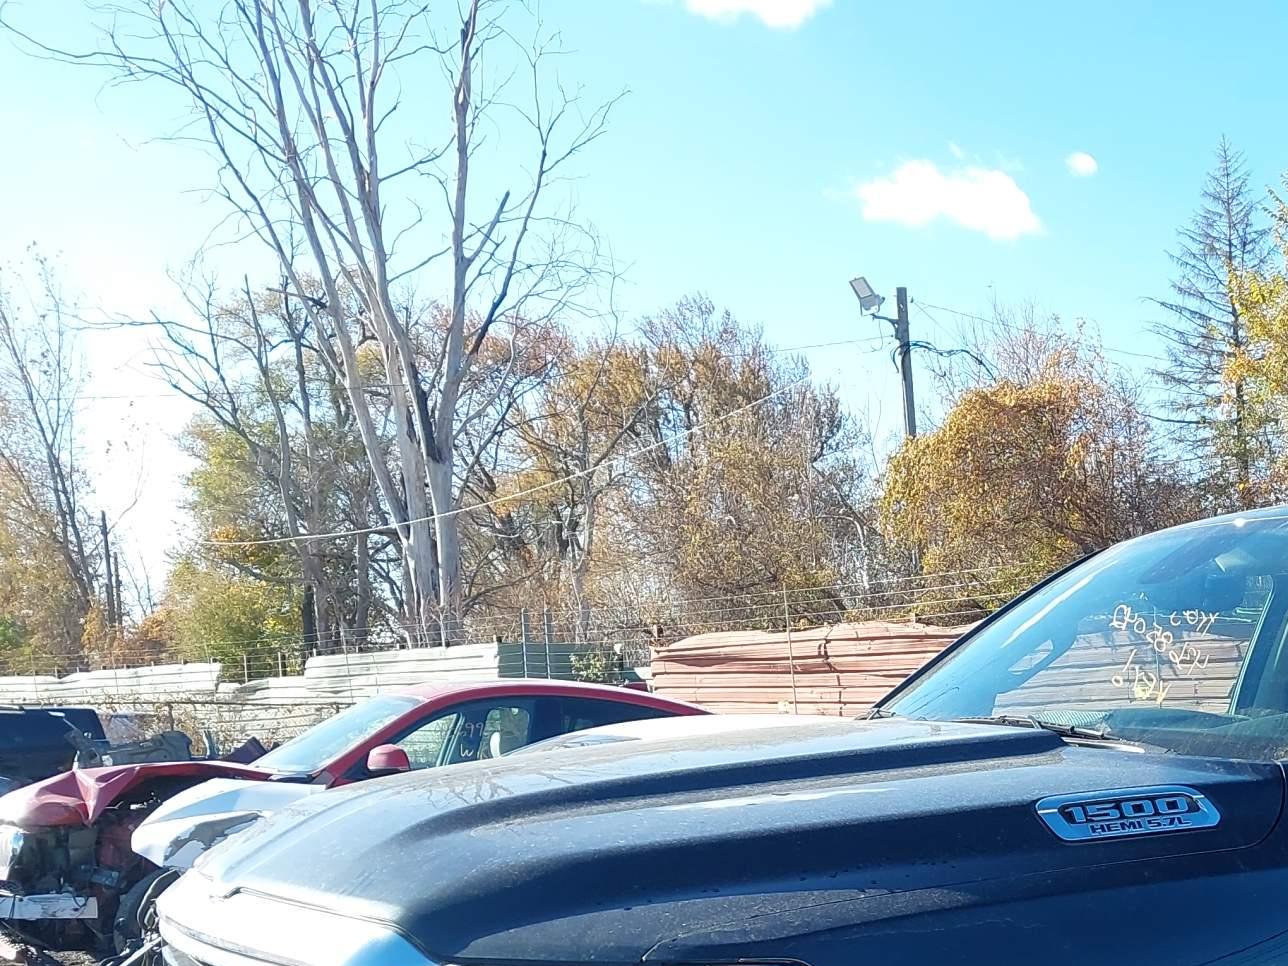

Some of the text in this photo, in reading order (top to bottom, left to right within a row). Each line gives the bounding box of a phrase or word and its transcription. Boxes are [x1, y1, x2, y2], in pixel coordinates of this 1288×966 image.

[1064, 796, 1189, 824] 1500
[1089, 814, 1192, 836] HEMI 5.7L
